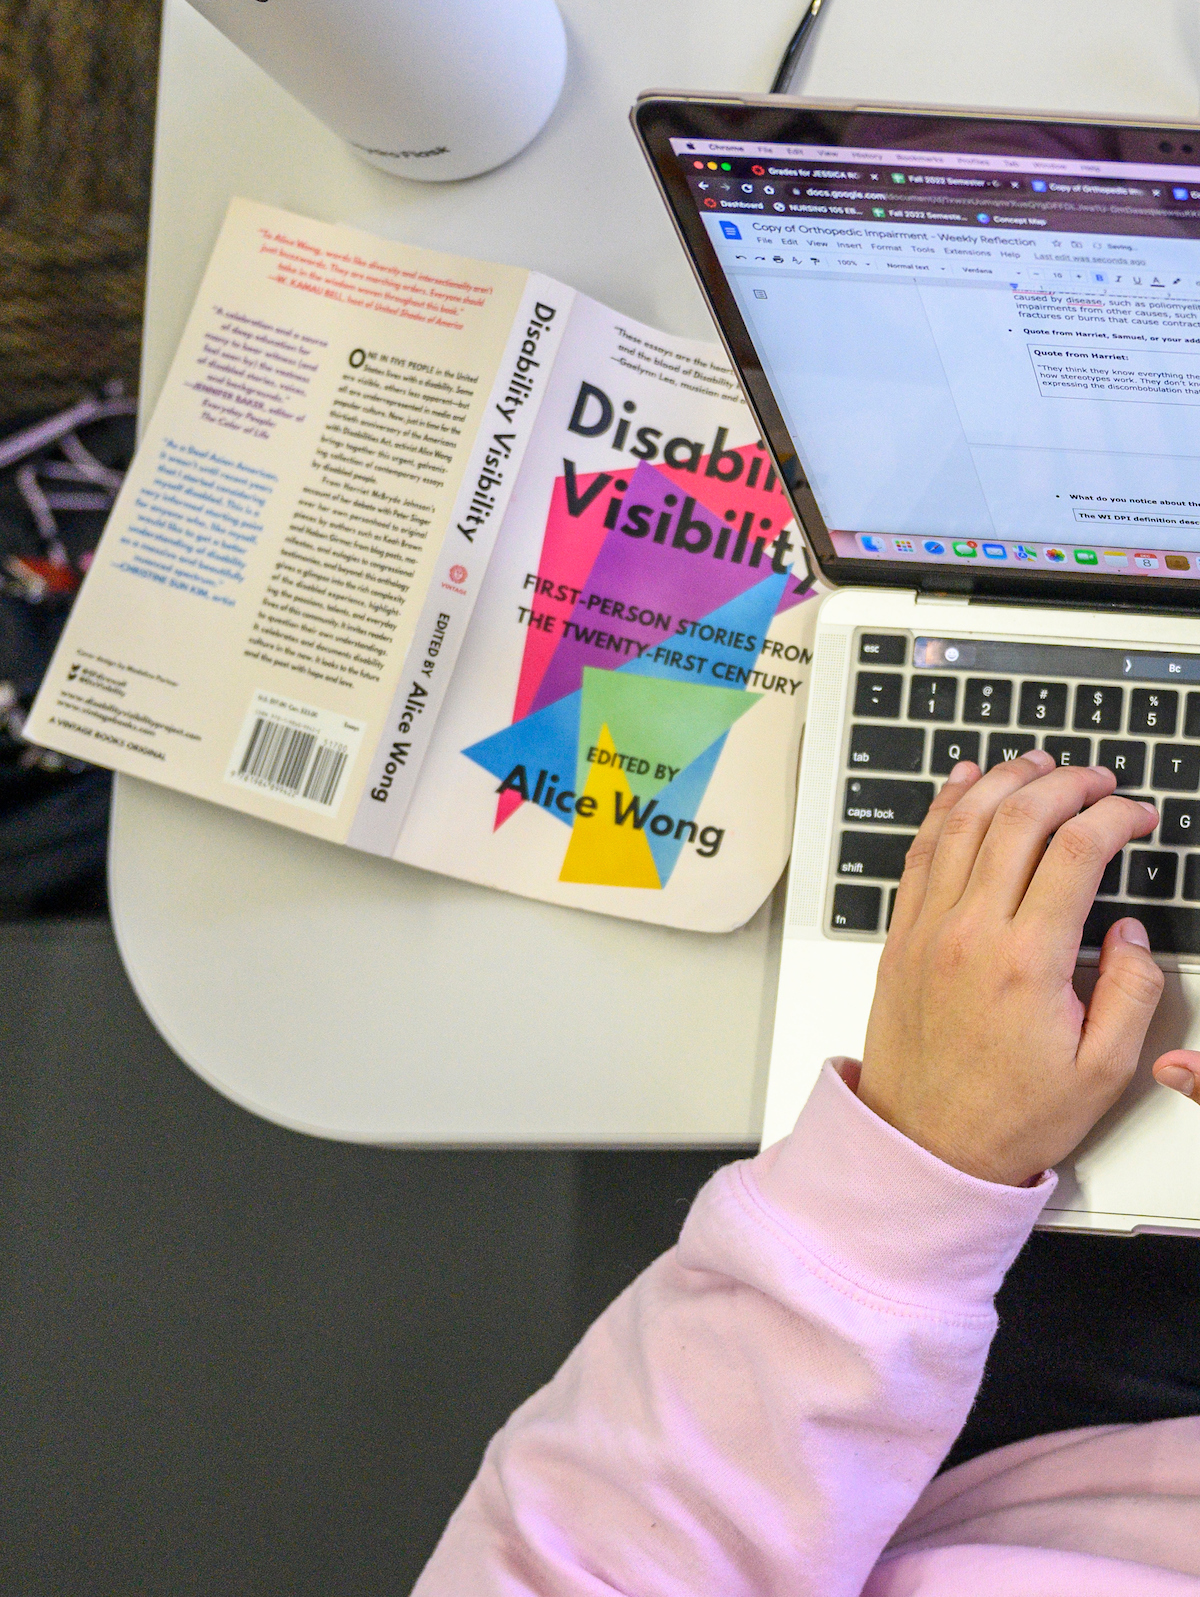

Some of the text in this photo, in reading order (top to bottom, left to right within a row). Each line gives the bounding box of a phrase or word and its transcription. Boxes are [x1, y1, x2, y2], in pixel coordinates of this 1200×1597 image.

[751, 221, 1036, 246] Copy of Orthopedic Impairment Weekly Reflection
[644, 342, 673, 357] essays
[675, 353, 690, 362] are
[694, 358, 707, 368] the
[1065, 350, 1088, 358] from
[1091, 352, 1128, 360] Harriet:
[618, 344, 734, 389] and the blood of Disability
[1064, 365, 1087, 373] think
[1089, 367, 1109, 375] they
[1137, 371, 1183, 381] everything
[1060, 373, 1111, 382] stereotypes
[1139, 377, 1161, 385] They
[659, 372, 678, 386] Lea,
[681, 382, 719, 397] musician
[722, 391, 738, 402] and
[1041, 380, 1088, 389] expressing
[1107, 383, 1182, 393] discombobulation
[457, 302, 557, 544] Disability Visibility
[441, 582, 467, 595] VINTAGE
[522, 573, 671, 631] FIRST-PERSON
[676, 619, 756, 652] STORIES
[421, 612, 450, 678] EDITED BY
[517, 606, 803, 696] THE TWENTY-FIRST CENTURY
[864, 644, 880, 653] esc
[1169, 663, 1181, 673] Bc
[929, 700, 935, 713] 1
[981, 702, 991, 716] 2
[1036, 705, 1046, 719] 3
[1091, 710, 1101, 724] 4
[1147, 712, 1157, 726] 5
[370, 682, 428, 803] Alice Wong
[853, 752, 870, 762] tab
[948, 745, 961, 760] Q
[1061, 752, 1071, 766] E
[586, 746, 681, 783] EDITED BY
[1115, 755, 1126, 769] R
[1172, 759, 1182, 773] T
[495, 764, 726, 858] Alice Wong
[847, 808, 894, 821] caps lock
[1180, 815, 1191, 828] G
[841, 861, 864, 874] shift
[1147, 867, 1158, 880] V
[835, 915, 846, 924] fn
